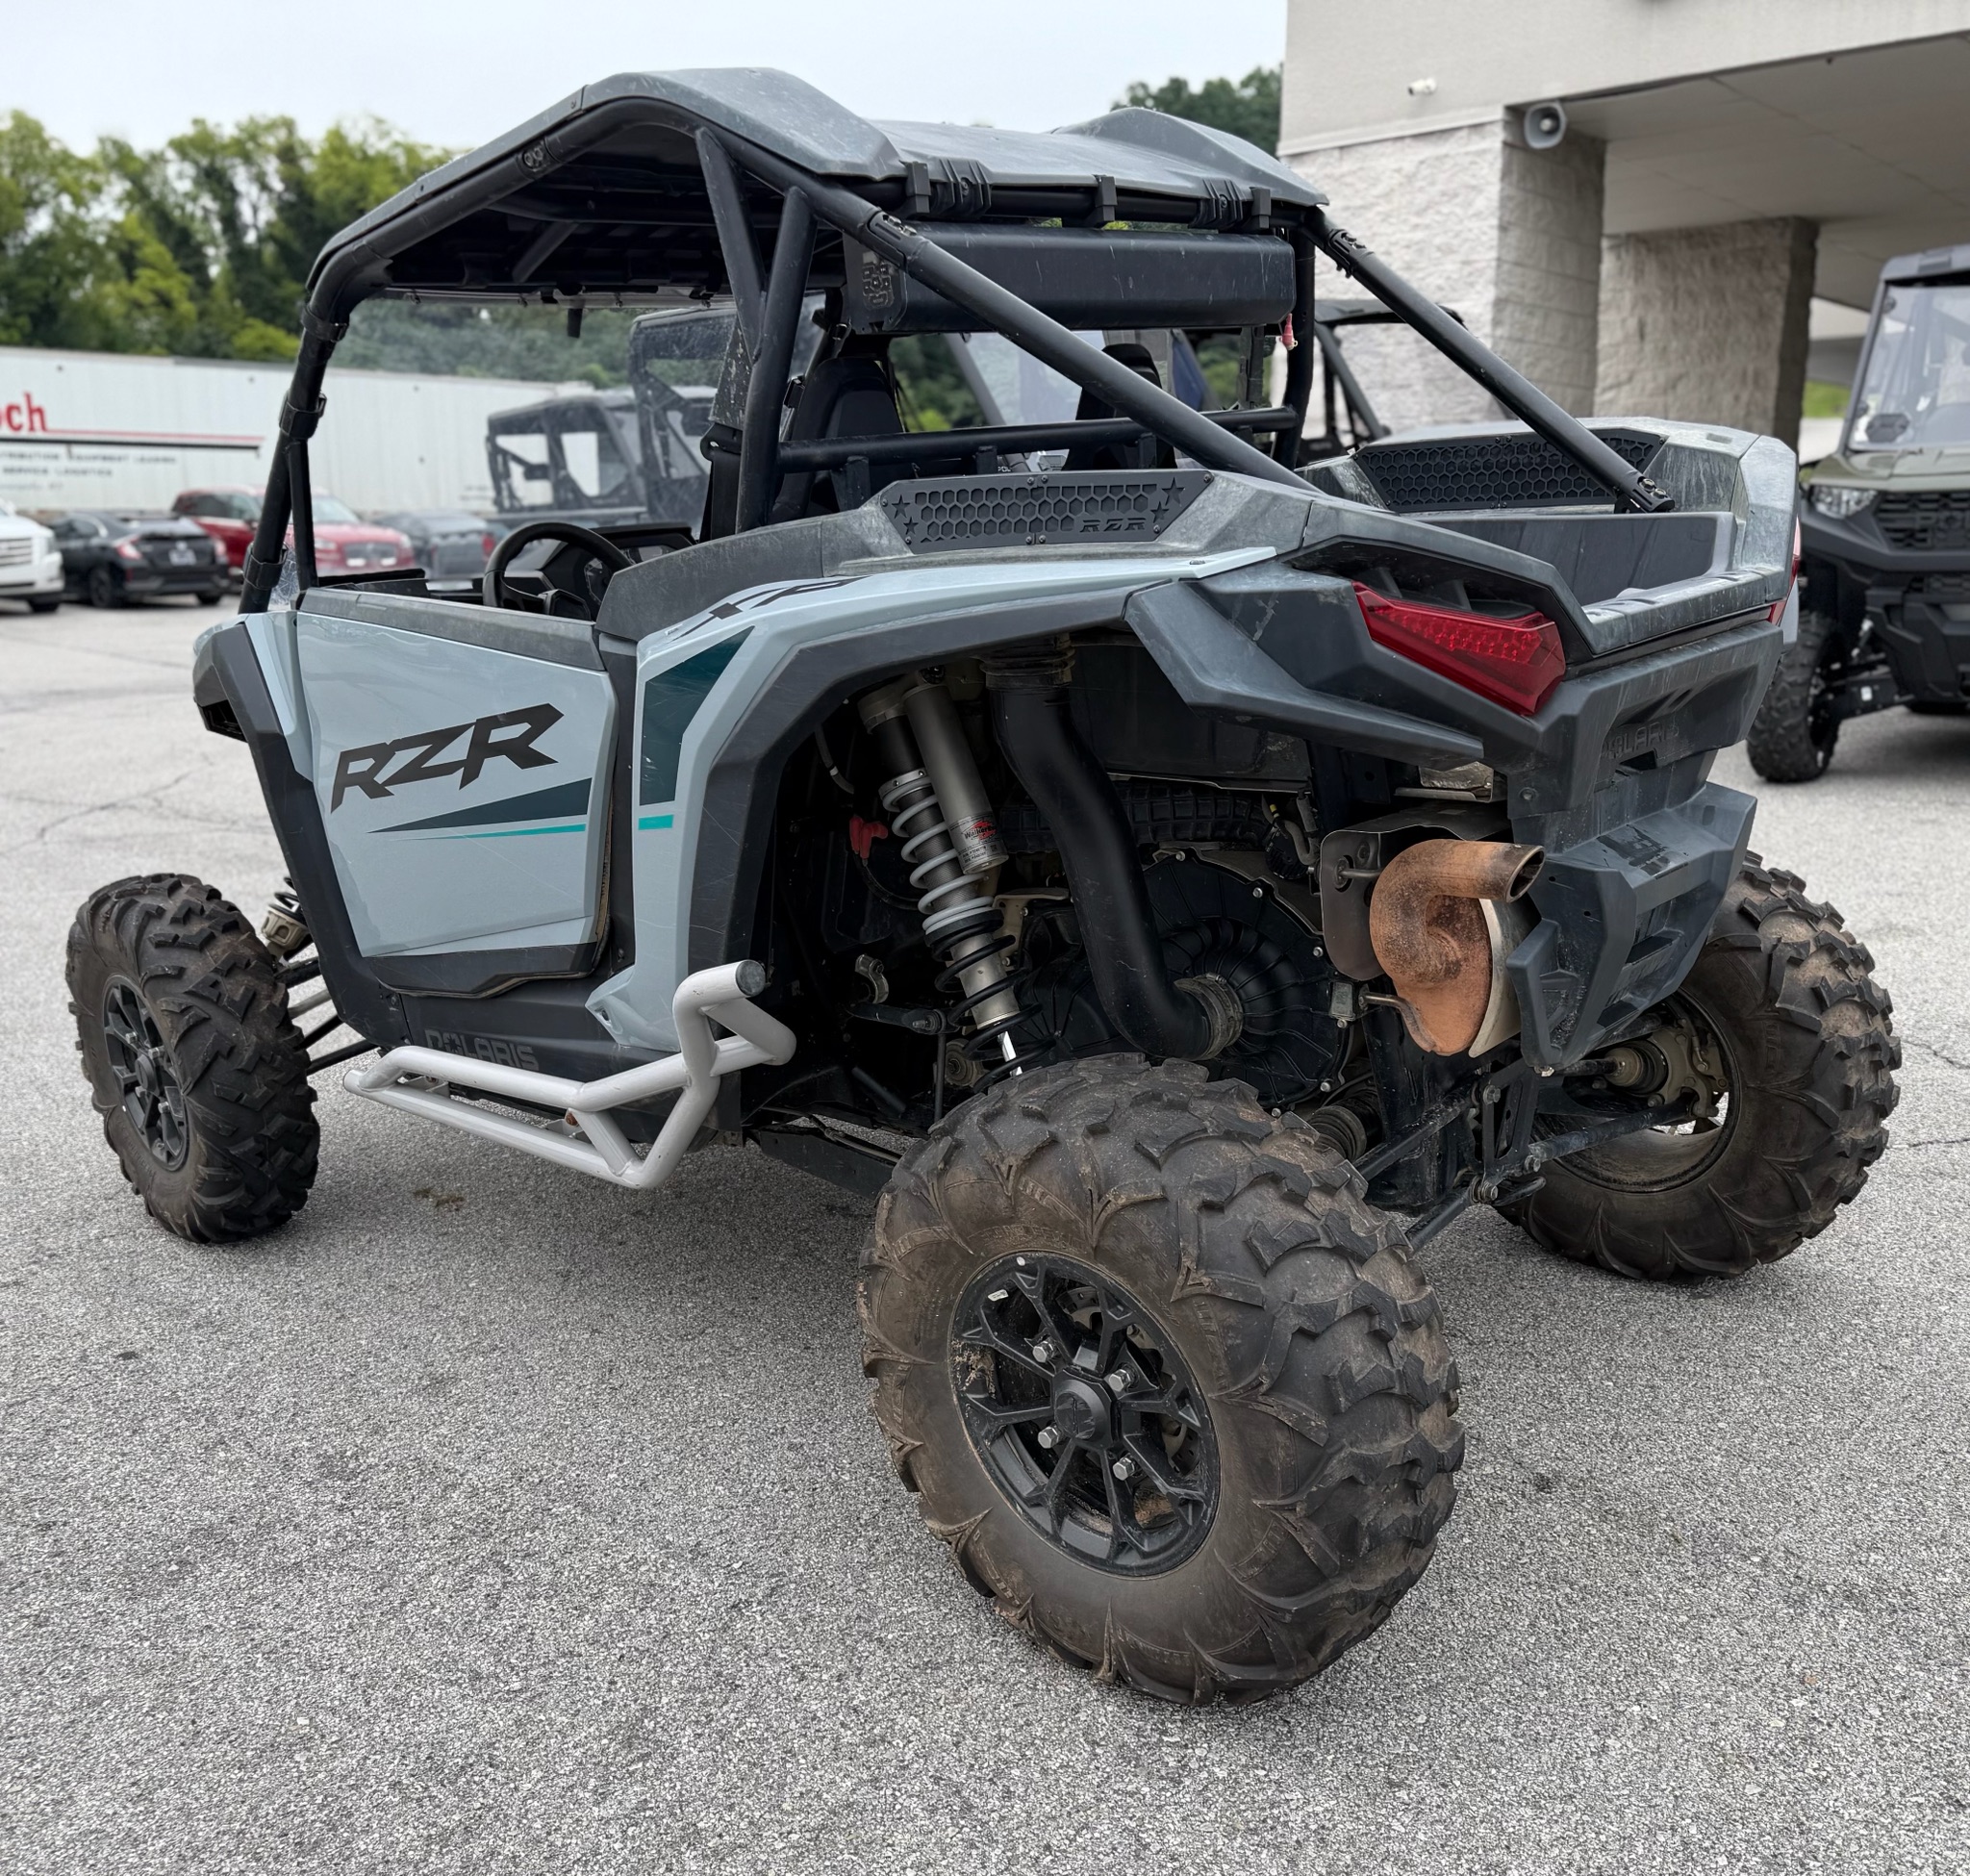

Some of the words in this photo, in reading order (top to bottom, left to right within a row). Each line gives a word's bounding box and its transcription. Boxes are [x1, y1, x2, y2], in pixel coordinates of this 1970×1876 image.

[0, 391, 47, 433] ch
[331, 703, 565, 814] RZR
[424, 1028, 540, 1072] POLARIS
